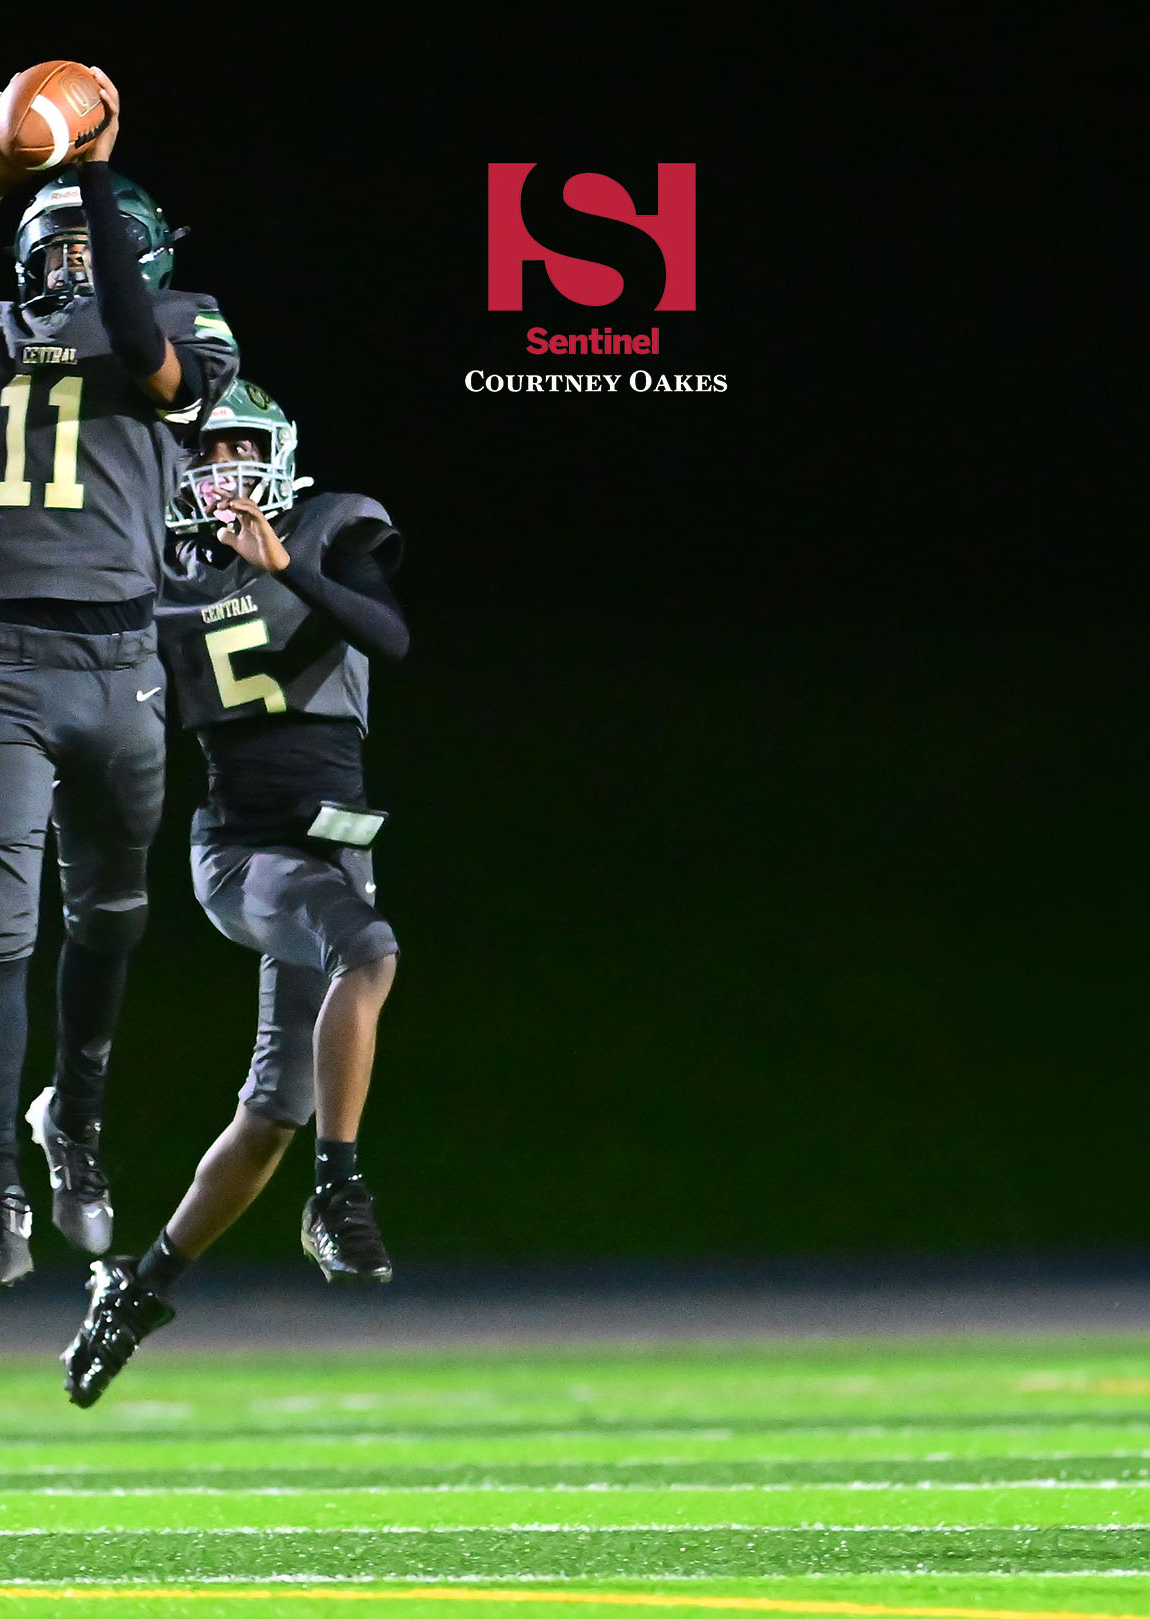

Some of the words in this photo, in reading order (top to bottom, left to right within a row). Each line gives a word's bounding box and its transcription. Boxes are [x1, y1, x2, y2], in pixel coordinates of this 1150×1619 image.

[22, 346, 78, 365] CENTRAL
[201, 594, 258, 624] CENTRAL
[205, 618, 287, 714] 5
